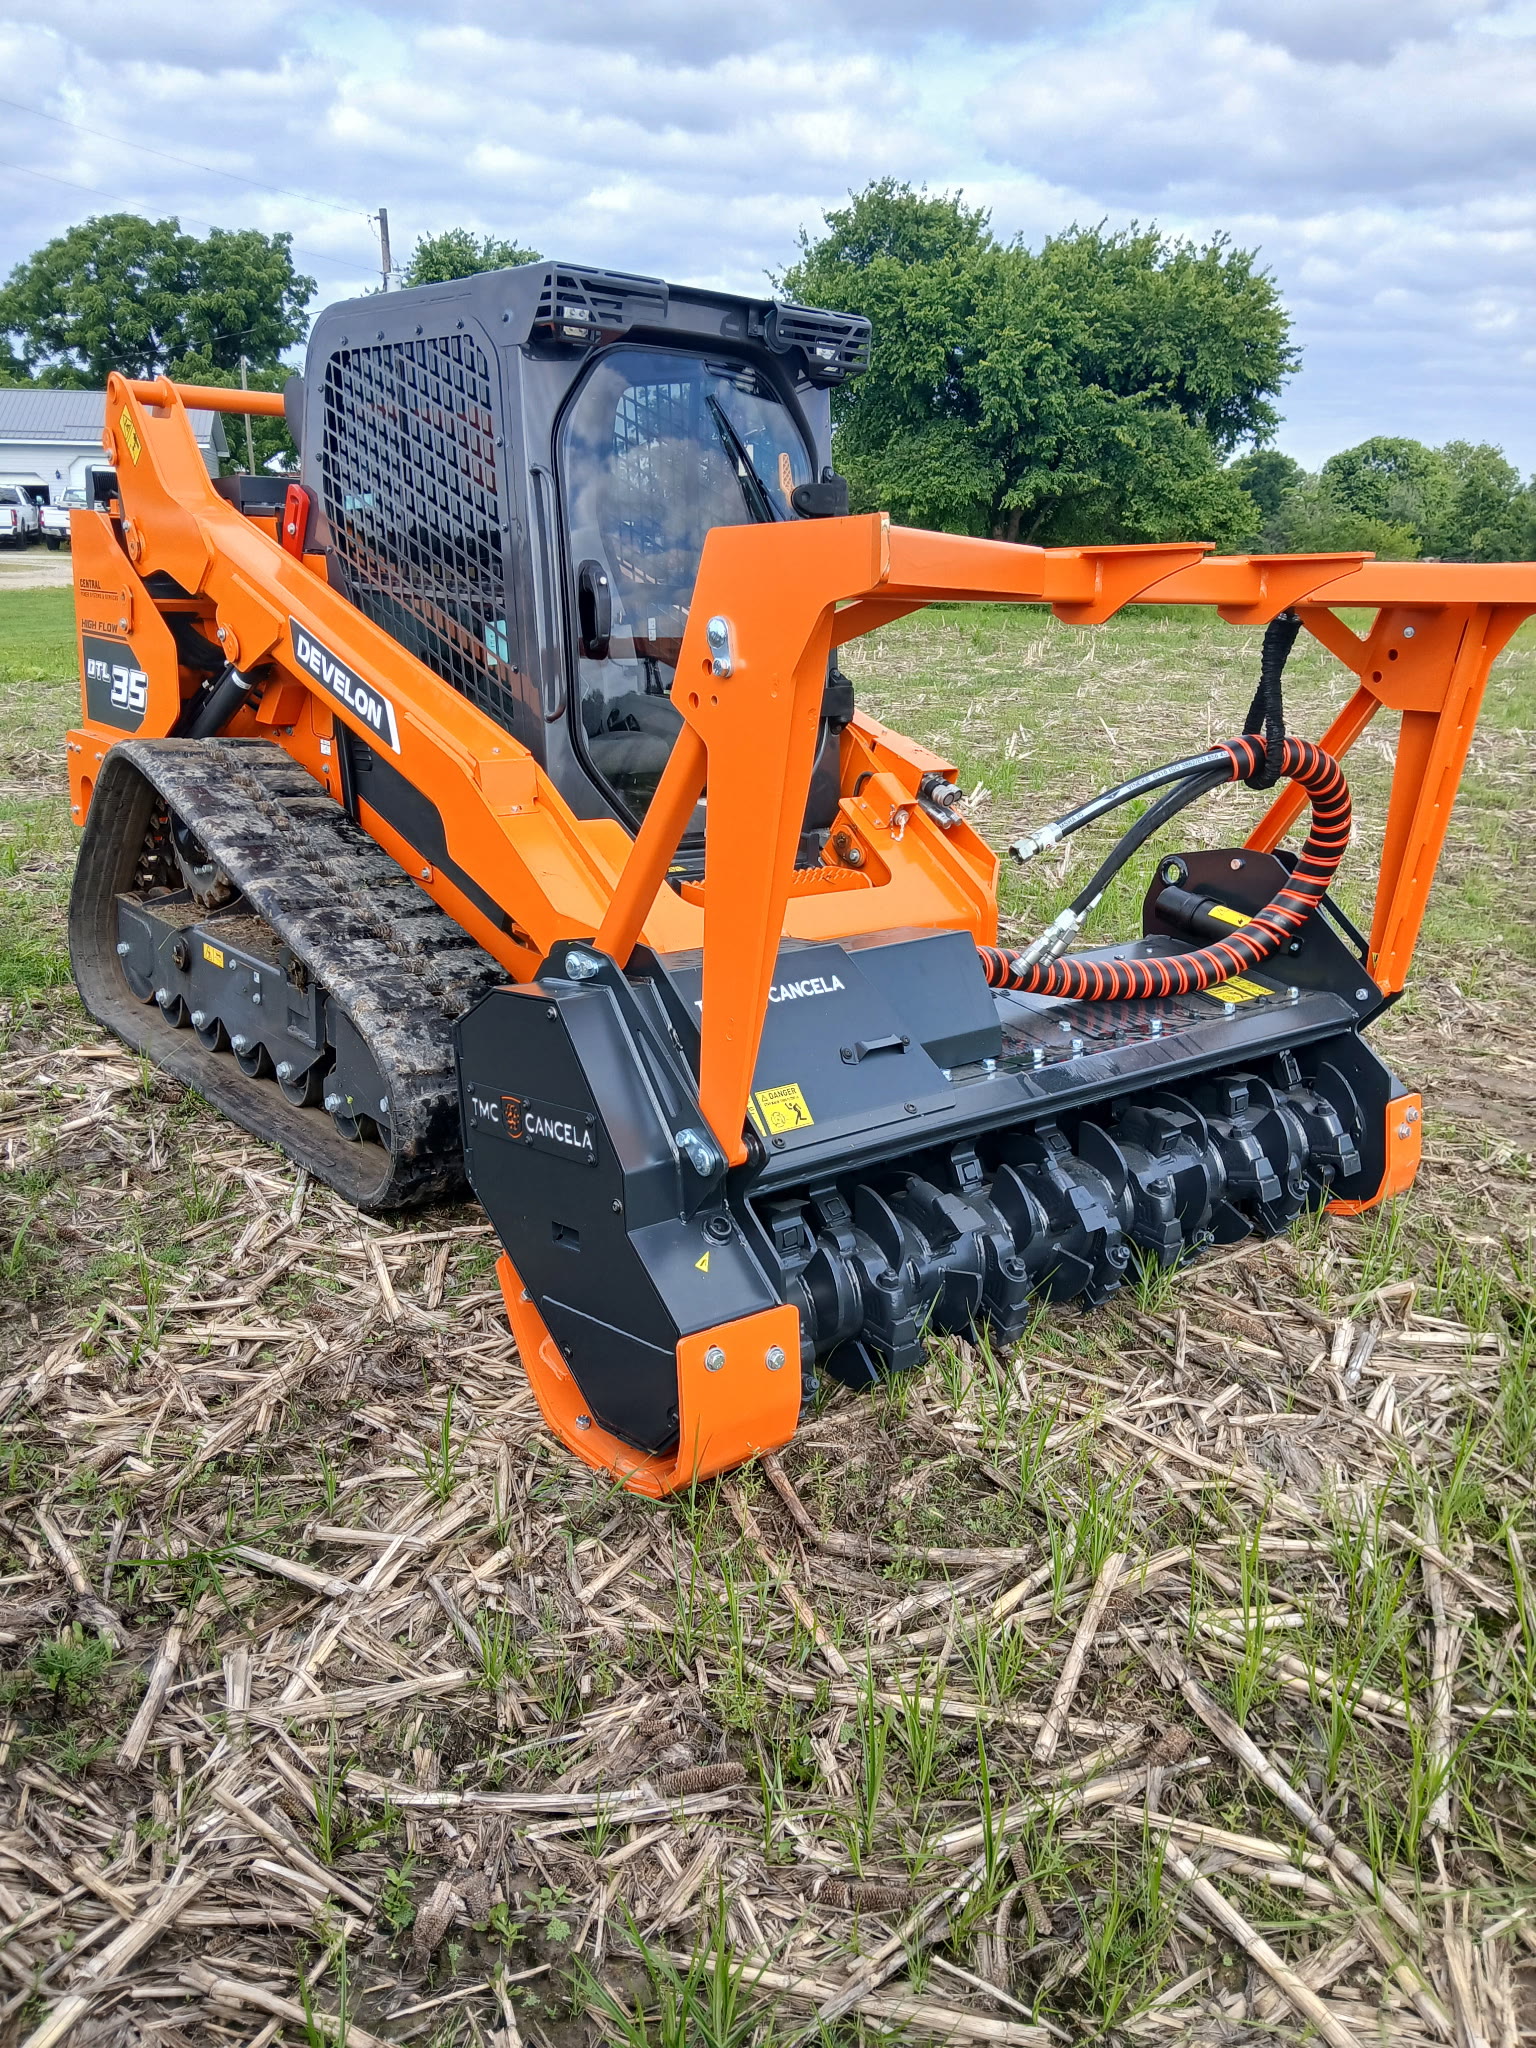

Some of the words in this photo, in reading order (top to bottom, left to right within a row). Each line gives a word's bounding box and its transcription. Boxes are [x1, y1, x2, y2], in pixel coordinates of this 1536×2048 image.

[80, 578, 101, 589] CENTRAL
[82, 618, 97, 630] HIGH
[98, 621, 118, 633] FLOW
[87, 658, 111, 683] DTL
[111, 664, 149, 715] 35
[297, 633, 382, 730] DEVELON
[768, 974, 846, 1003] CANCELA
[768, 1087, 797, 1100] DANGER
[472, 1097, 499, 1122] TMC
[525, 1112, 593, 1150] CANCELA
